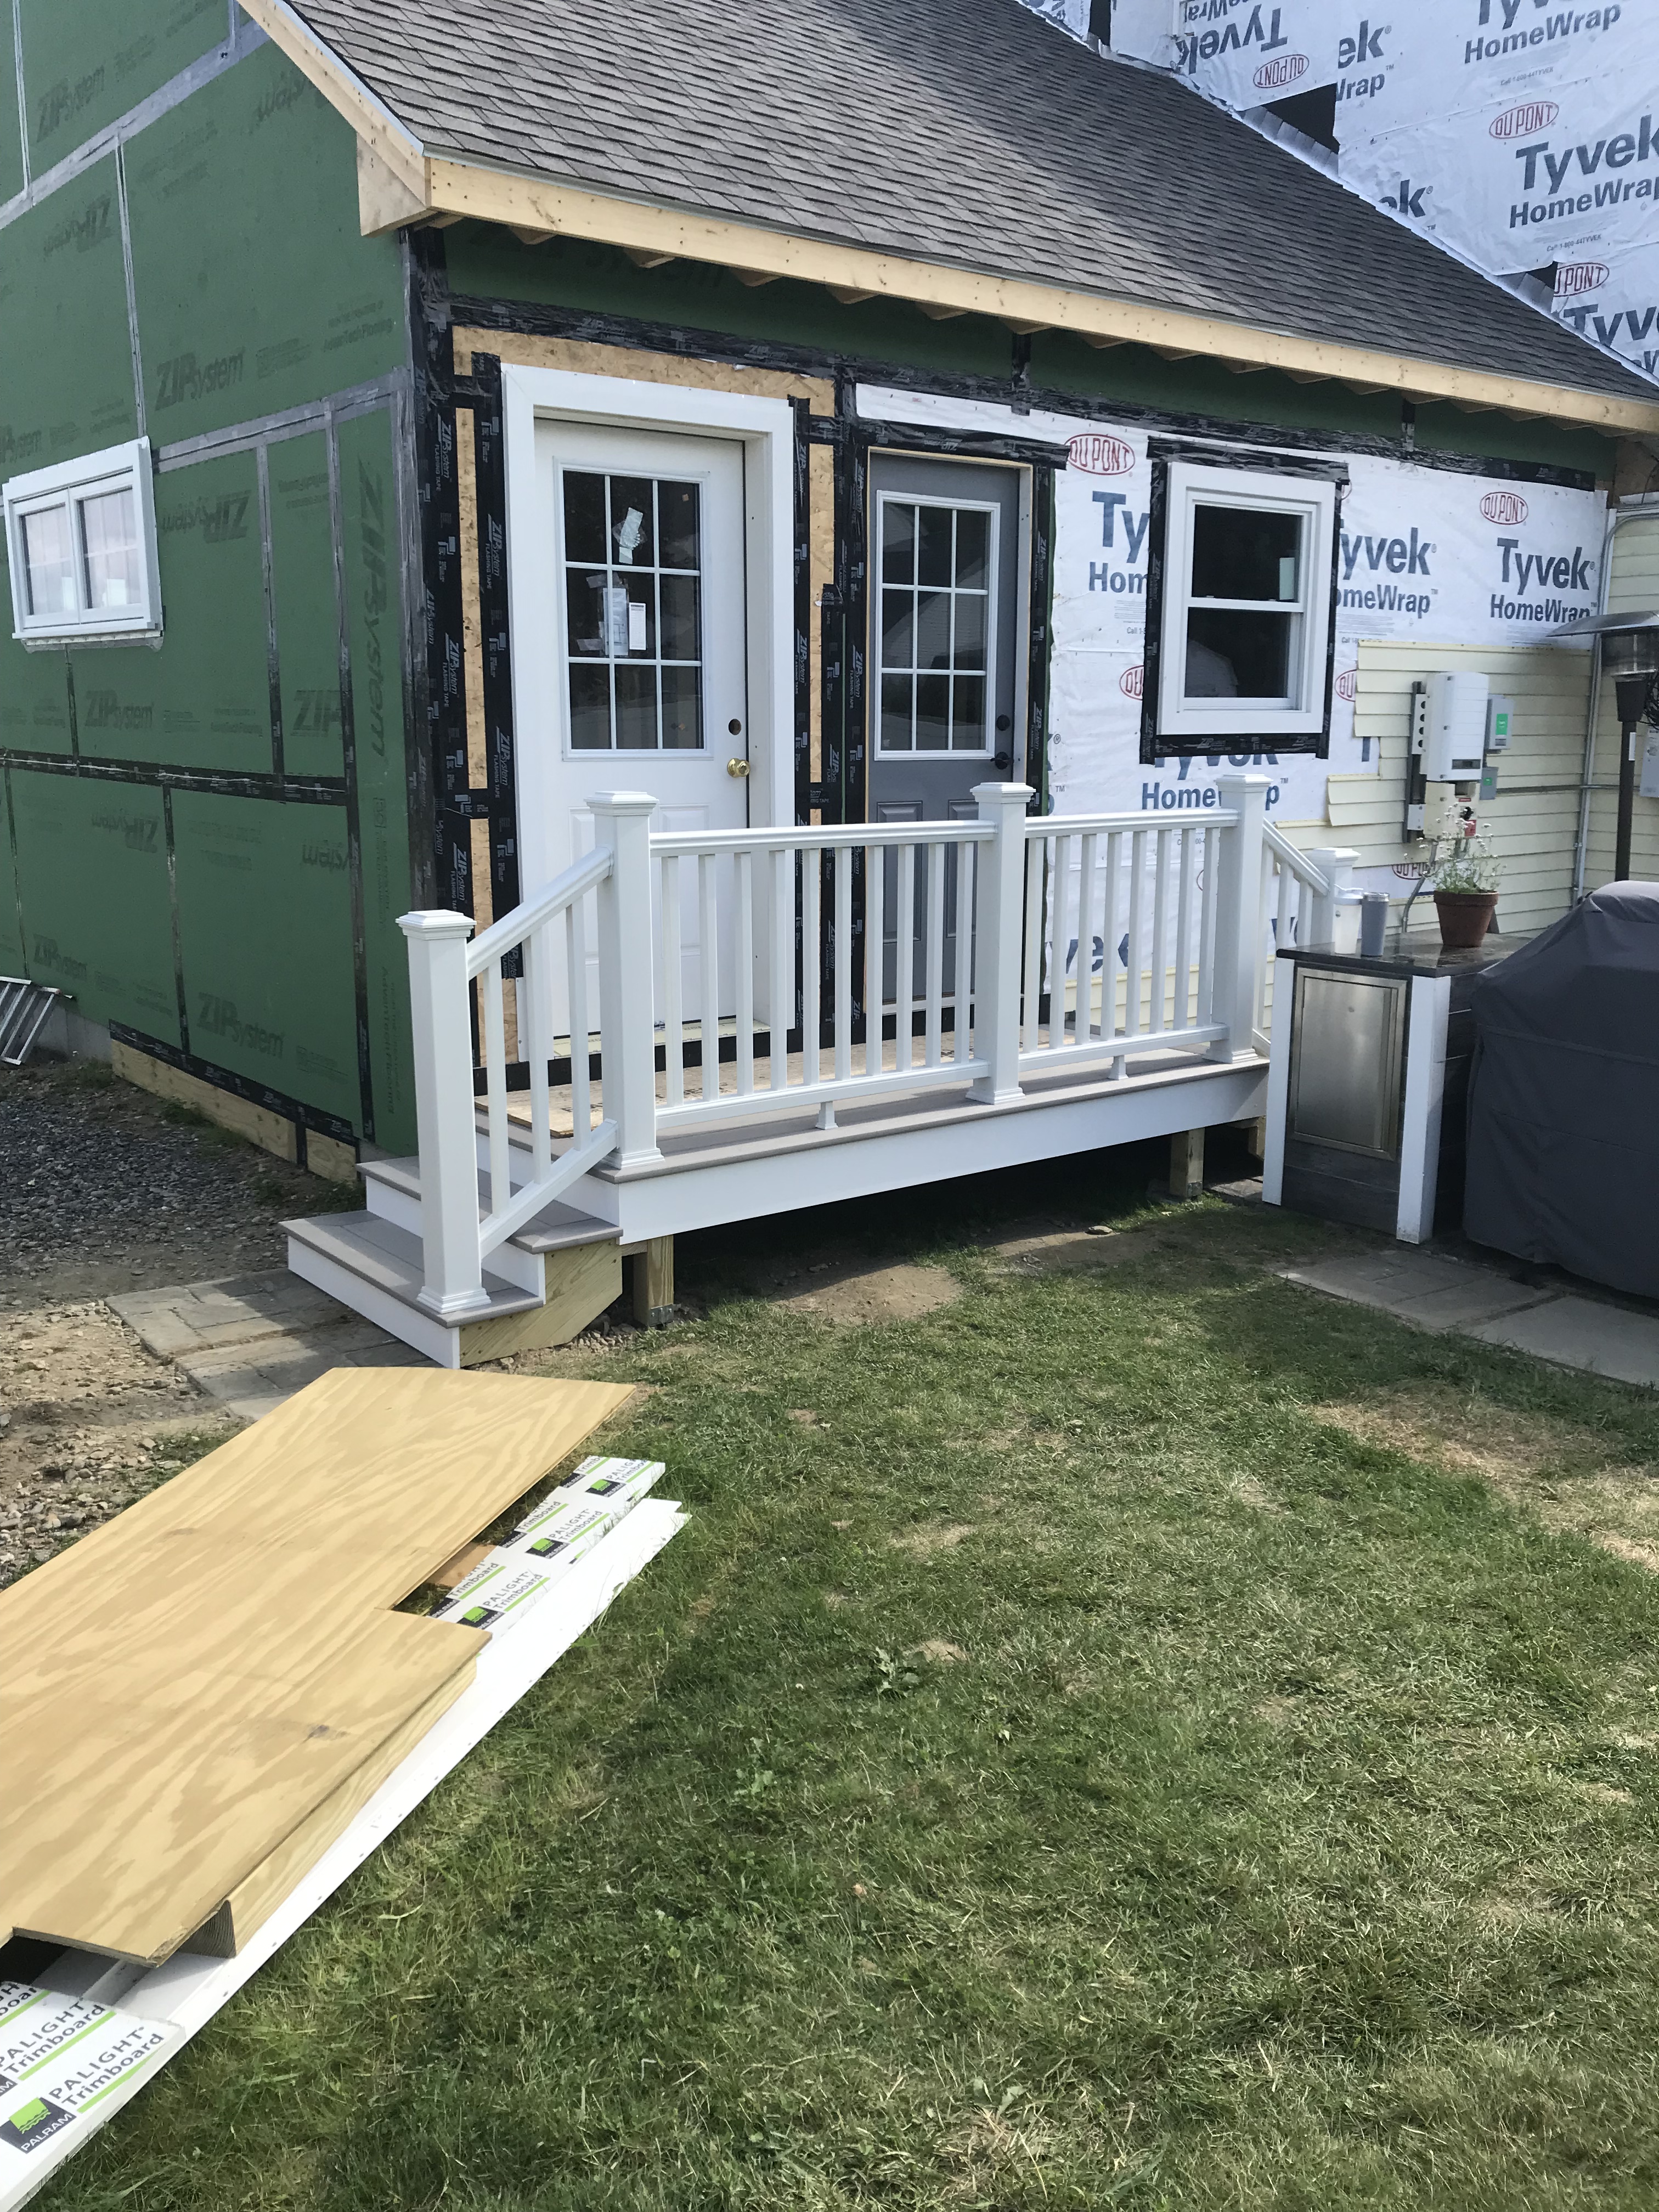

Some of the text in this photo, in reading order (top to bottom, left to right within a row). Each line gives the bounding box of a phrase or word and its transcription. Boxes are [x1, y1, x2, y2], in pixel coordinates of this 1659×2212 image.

[1465, 4, 1621, 64] HomeWrap
[1340, 524, 1431, 580] yvek
[1497, 538, 1590, 595] Tyvek
[517, 1502, 561, 1530] Trimboard
[549, 1510, 590, 1538] PALIGHT
[558, 1511, 603, 1541] Trimboard
[448, 1563, 499, 1596] Trimboard
[483, 1573, 528, 1606] PALIGHT
[493, 1573, 543, 1609] Trimboard
[3, 2004, 106, 2073] Trimboard
[49, 2029, 143, 2100] PALIGHT
[61, 2033, 165, 2106] Trimboard
[21, 2113, 72, 2151] PALRAM
